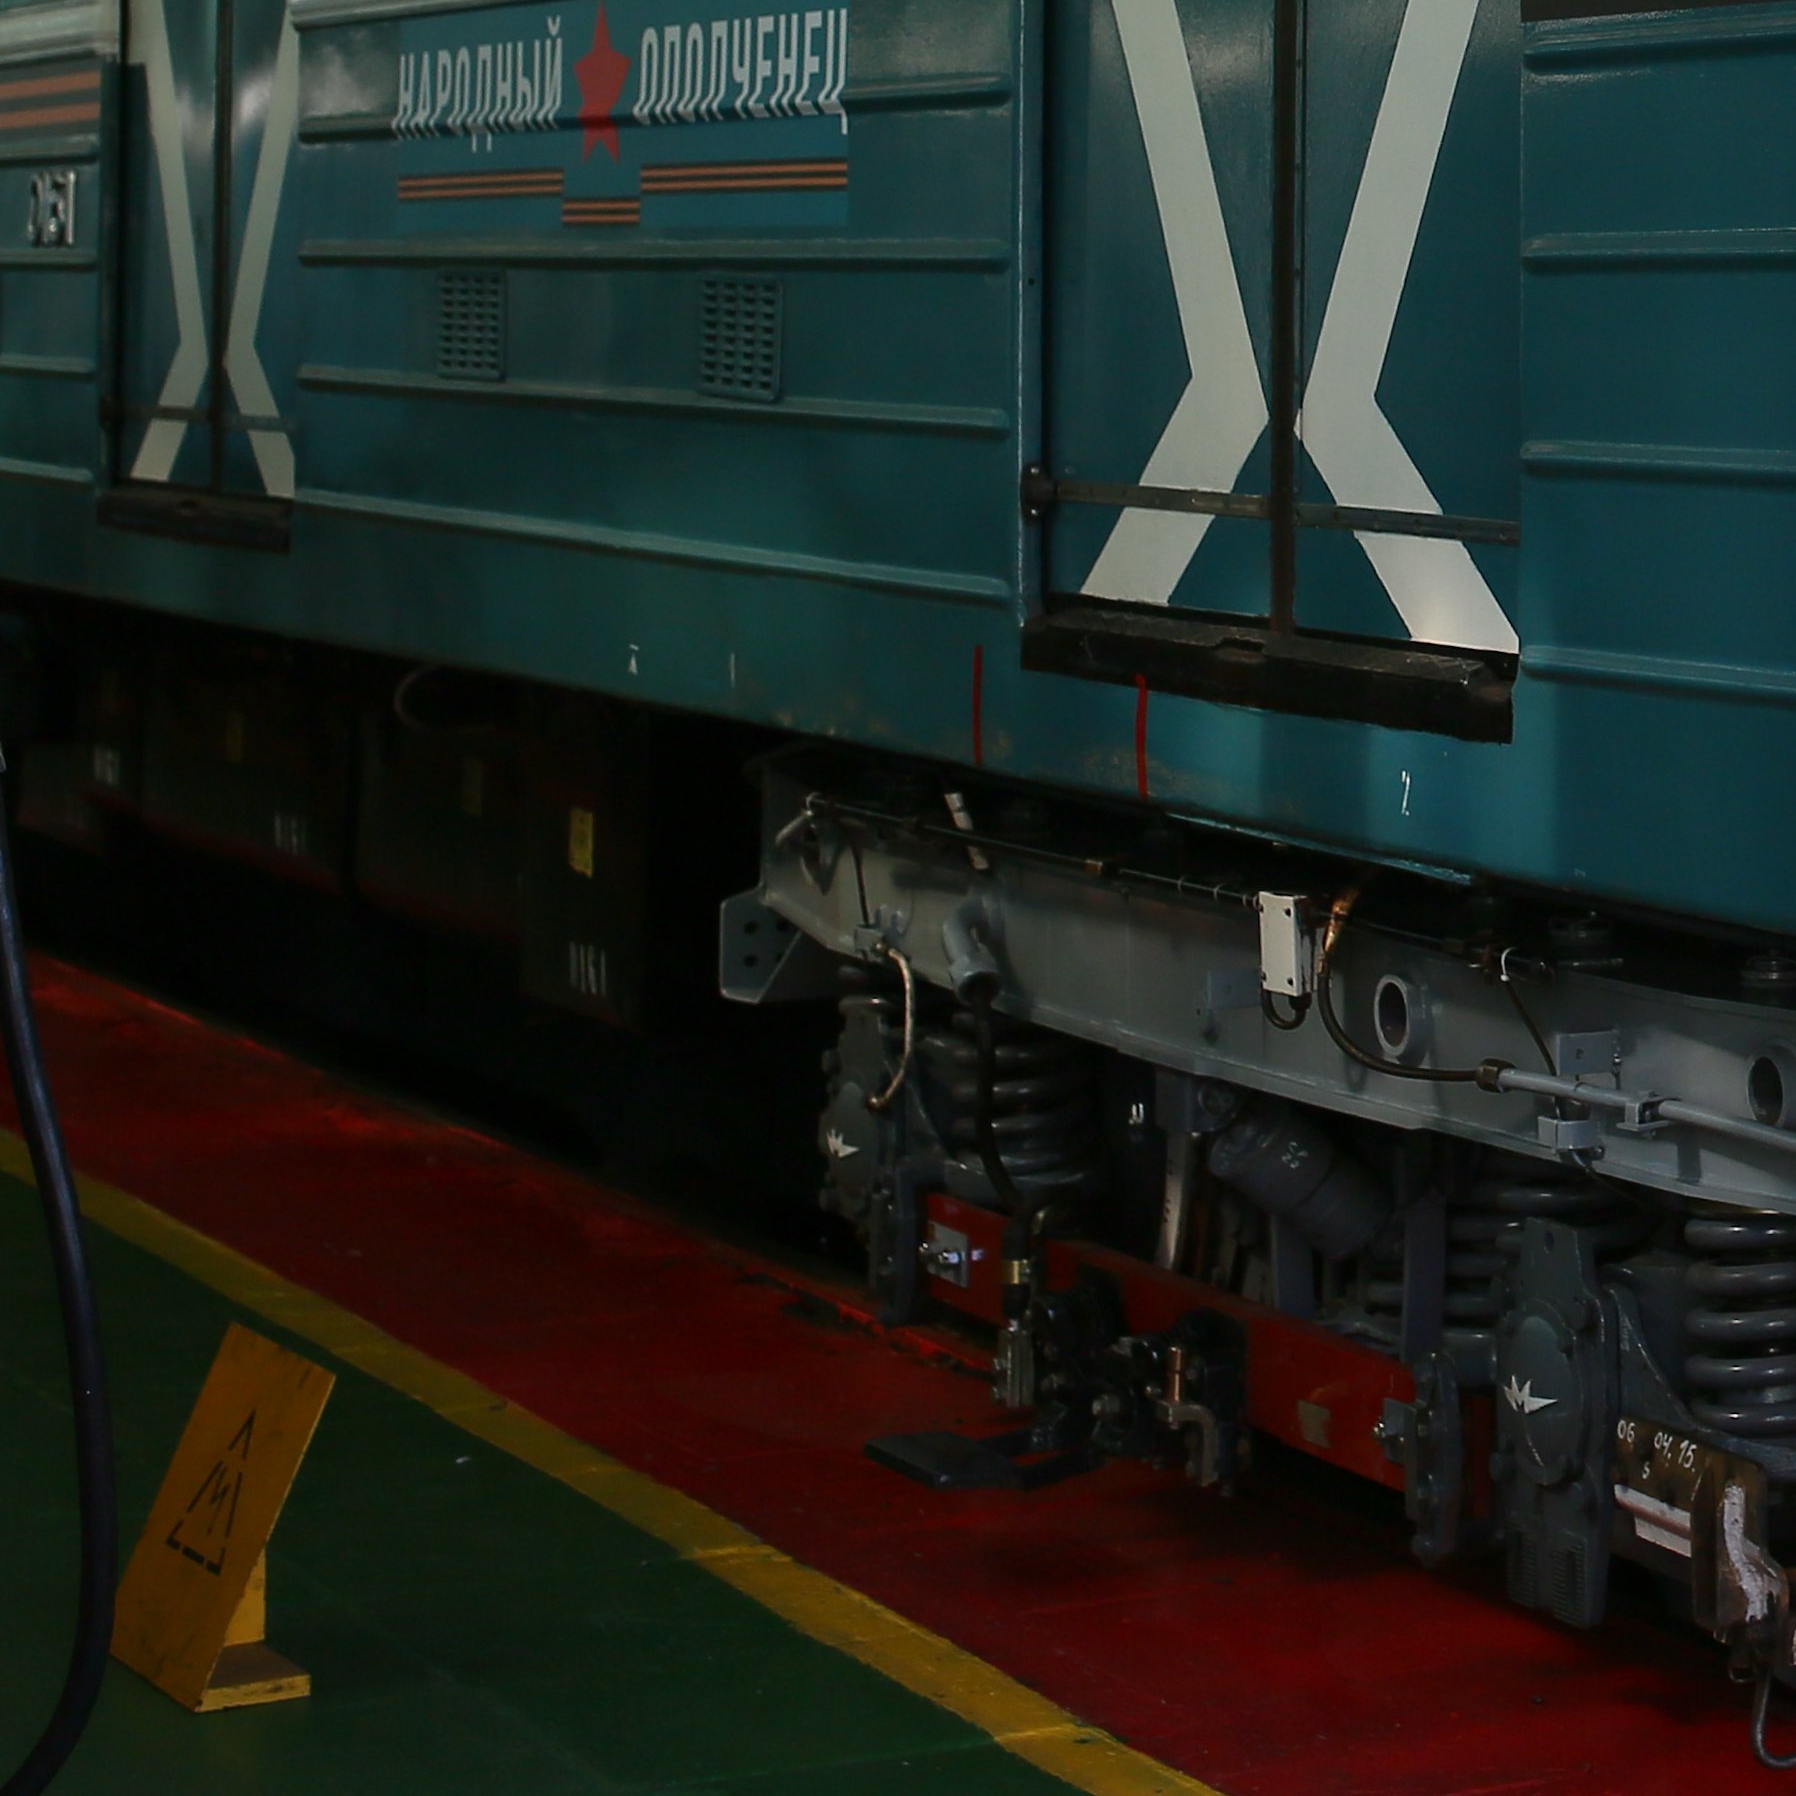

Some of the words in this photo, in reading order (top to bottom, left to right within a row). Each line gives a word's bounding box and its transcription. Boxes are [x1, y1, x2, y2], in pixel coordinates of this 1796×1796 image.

[391, 15, 564, 153] НАРОДНЫЙ
[632, 7, 849, 135] ОПОЛЧЕНЕЦ
[1617, 1419, 1636, 1443] 06
